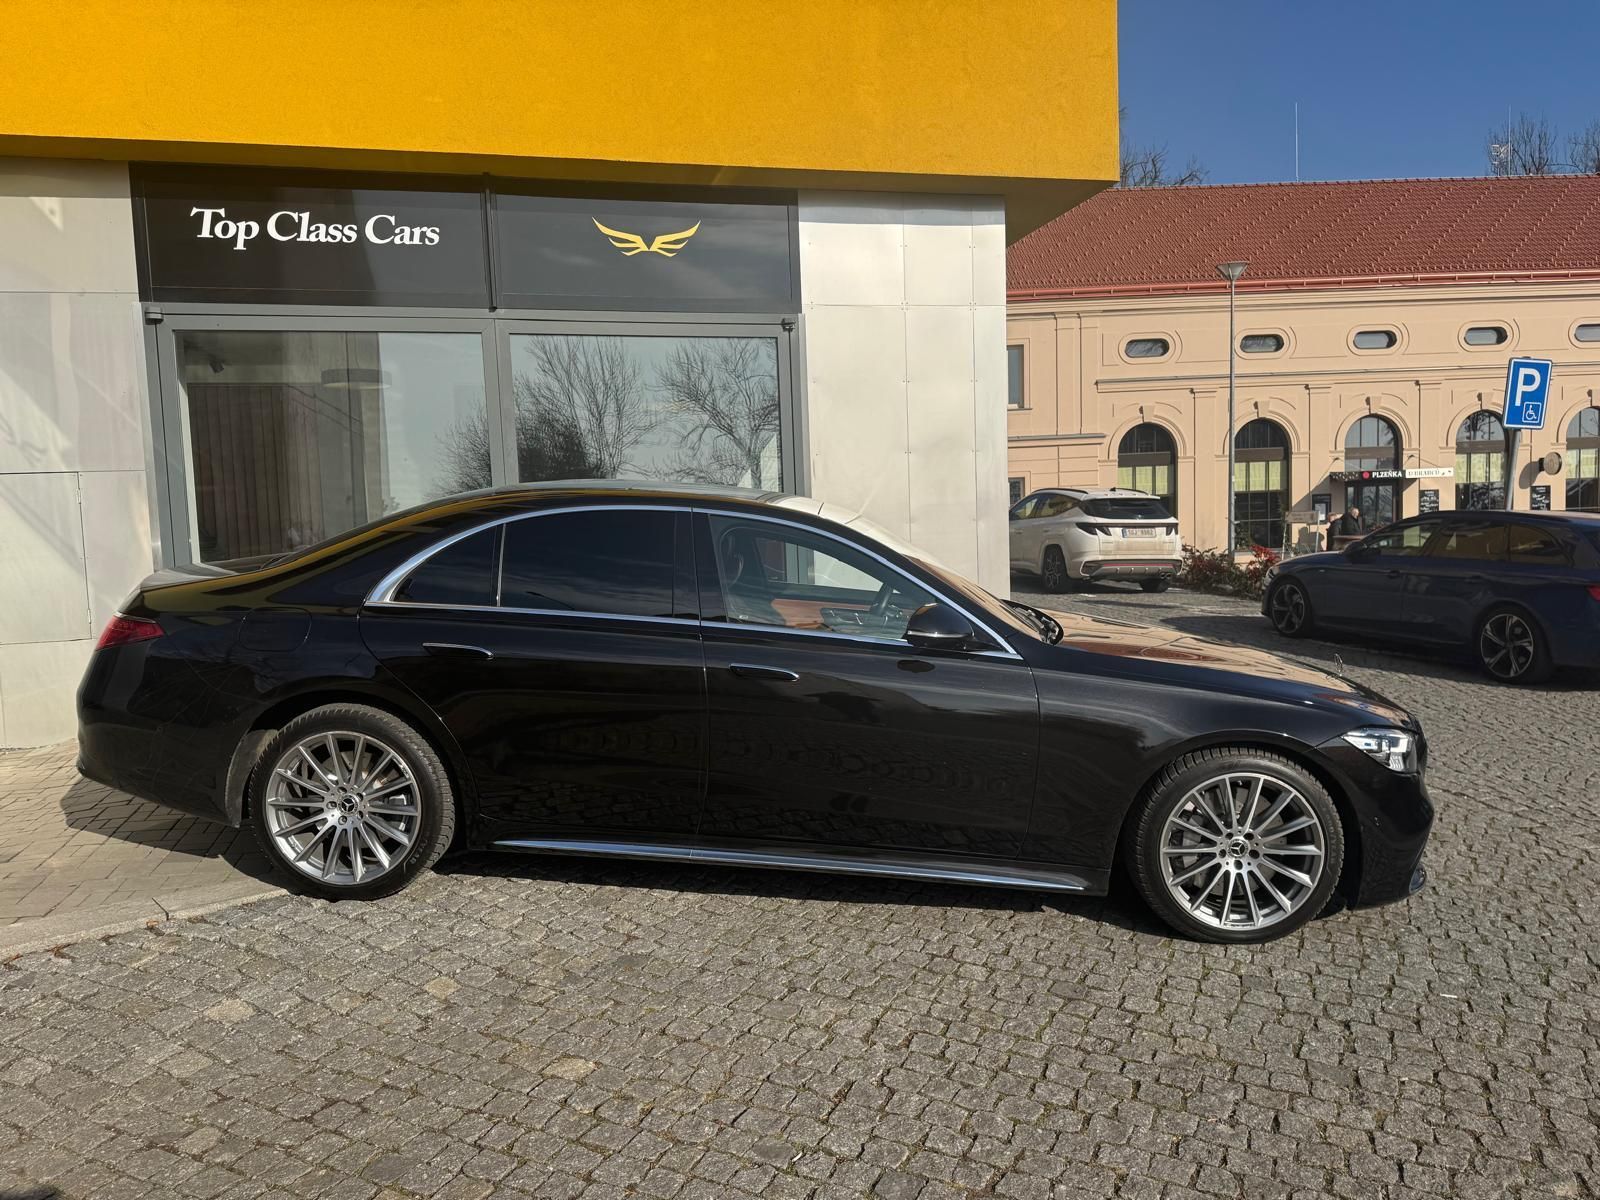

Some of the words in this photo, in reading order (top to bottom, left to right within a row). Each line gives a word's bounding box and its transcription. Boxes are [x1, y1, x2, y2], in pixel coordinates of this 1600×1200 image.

[190, 207, 259, 250] Top
[267, 211, 357, 243] Class
[365, 215, 439, 245] Cars
[1515, 368, 1541, 406] P
[1372, 470, 1402, 478] PLZEŇKA
